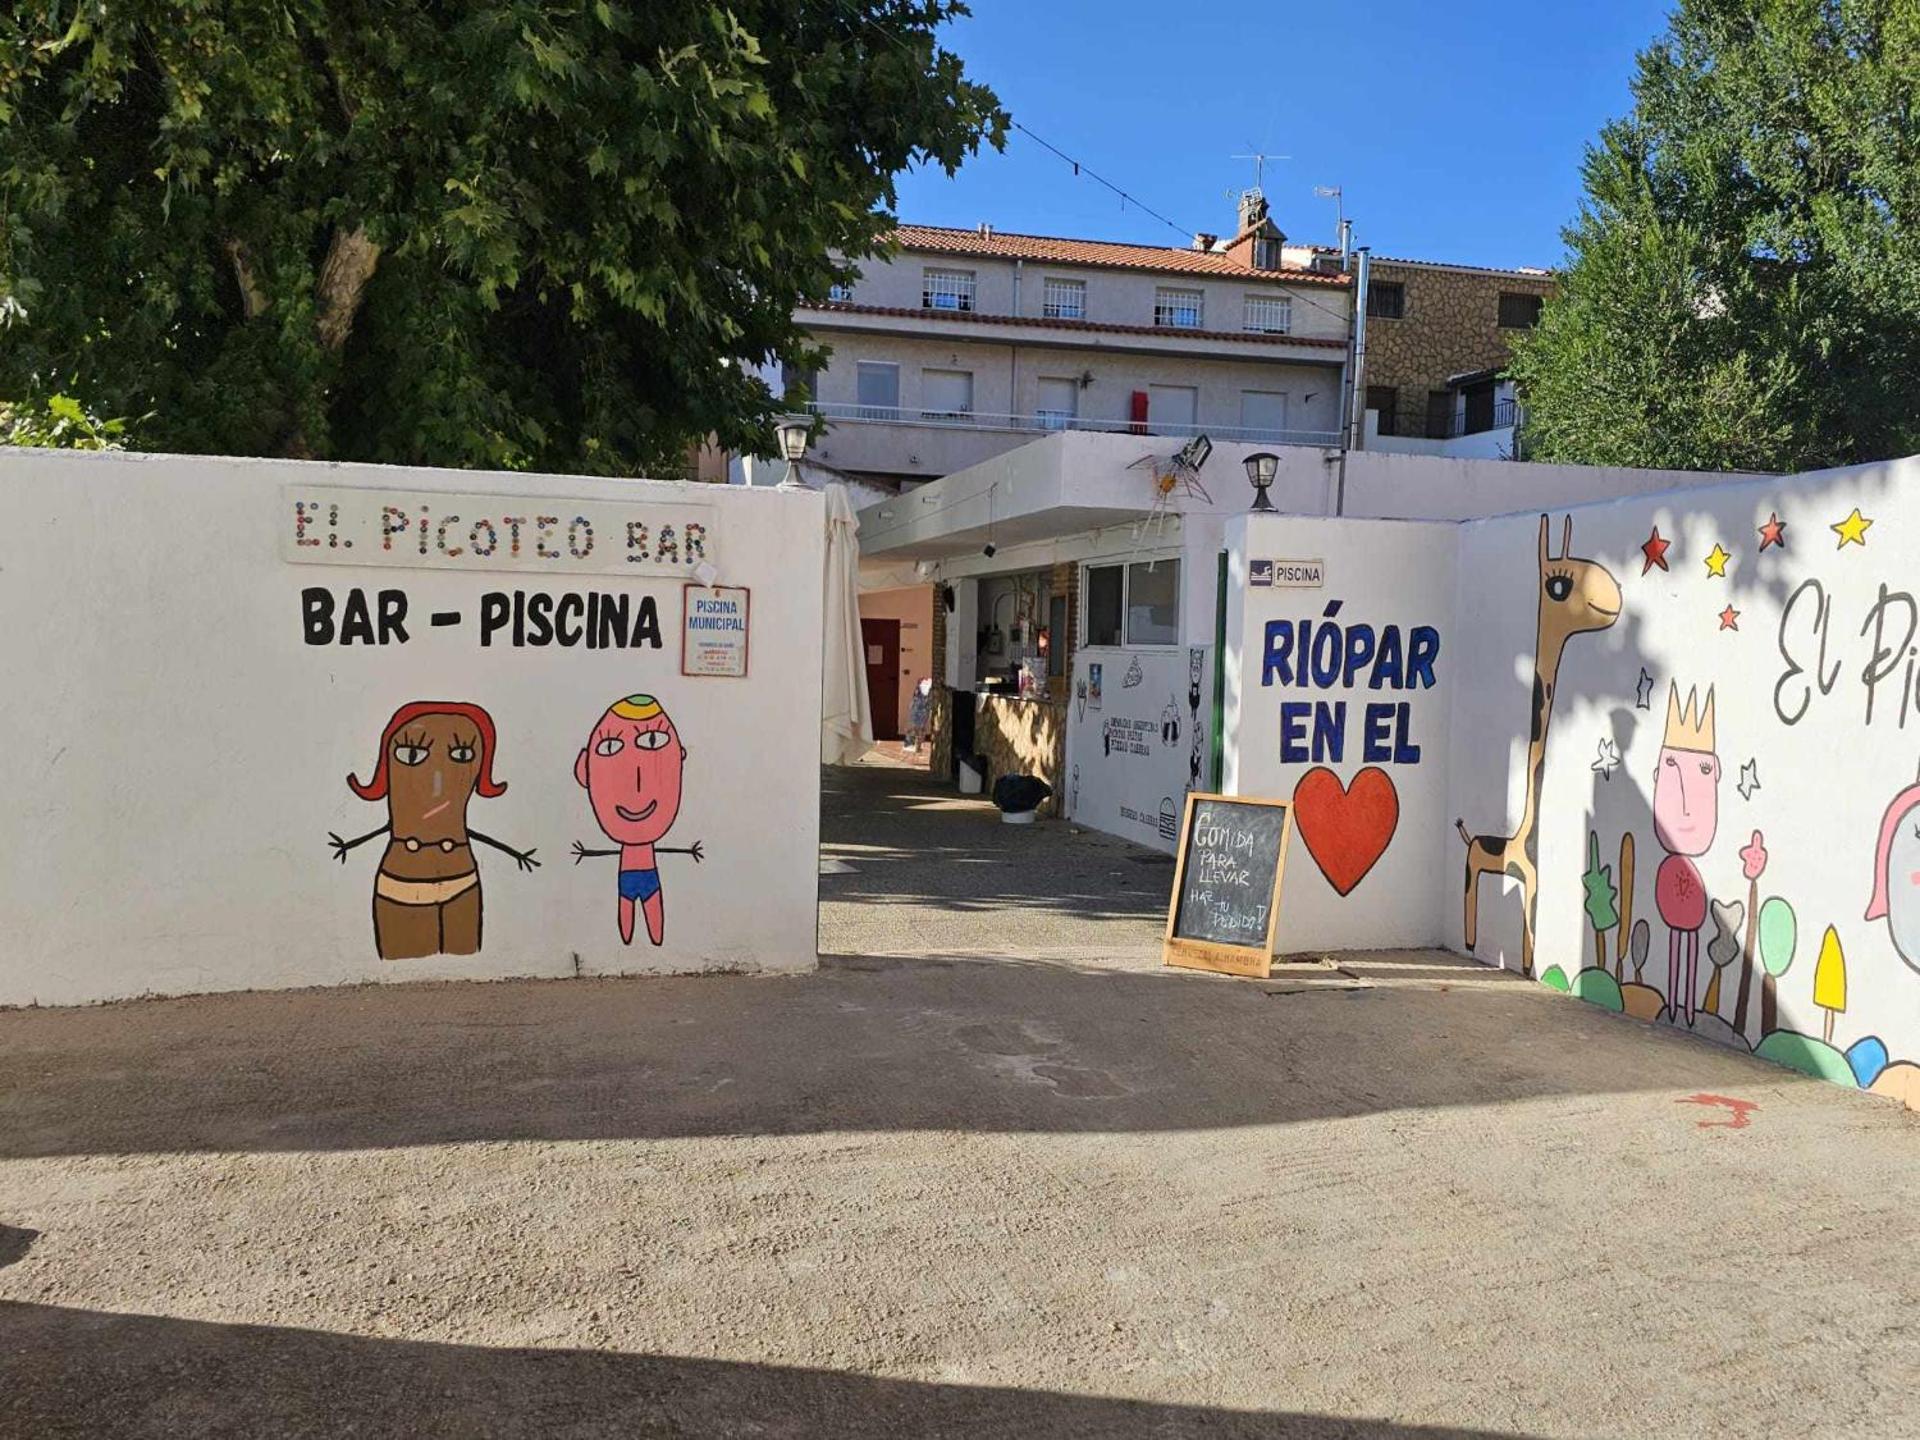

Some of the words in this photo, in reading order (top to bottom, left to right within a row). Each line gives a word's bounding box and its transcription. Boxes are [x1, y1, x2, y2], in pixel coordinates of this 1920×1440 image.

[294, 500, 353, 549] EL
[625, 520, 707, 565] BAR
[1276, 566, 1320, 582] PISCINA
[300, 586, 411, 646] BAR
[430, 610, 462, 627] -
[479, 589, 664, 650] PISCINA
[688, 616, 745, 631] MUNICIPAL
[696, 600, 738, 614] PISCINA
[1261, 599, 1440, 690] RIÓPAR
[1773, 578, 1842, 726] El
[1860, 582, 1920, 730] Pi
[1279, 700, 1347, 764] EN
[1362, 701, 1422, 765] EL
[1199, 848, 1238, 870] PARA
[1199, 868, 1250, 887] LLEVAR
